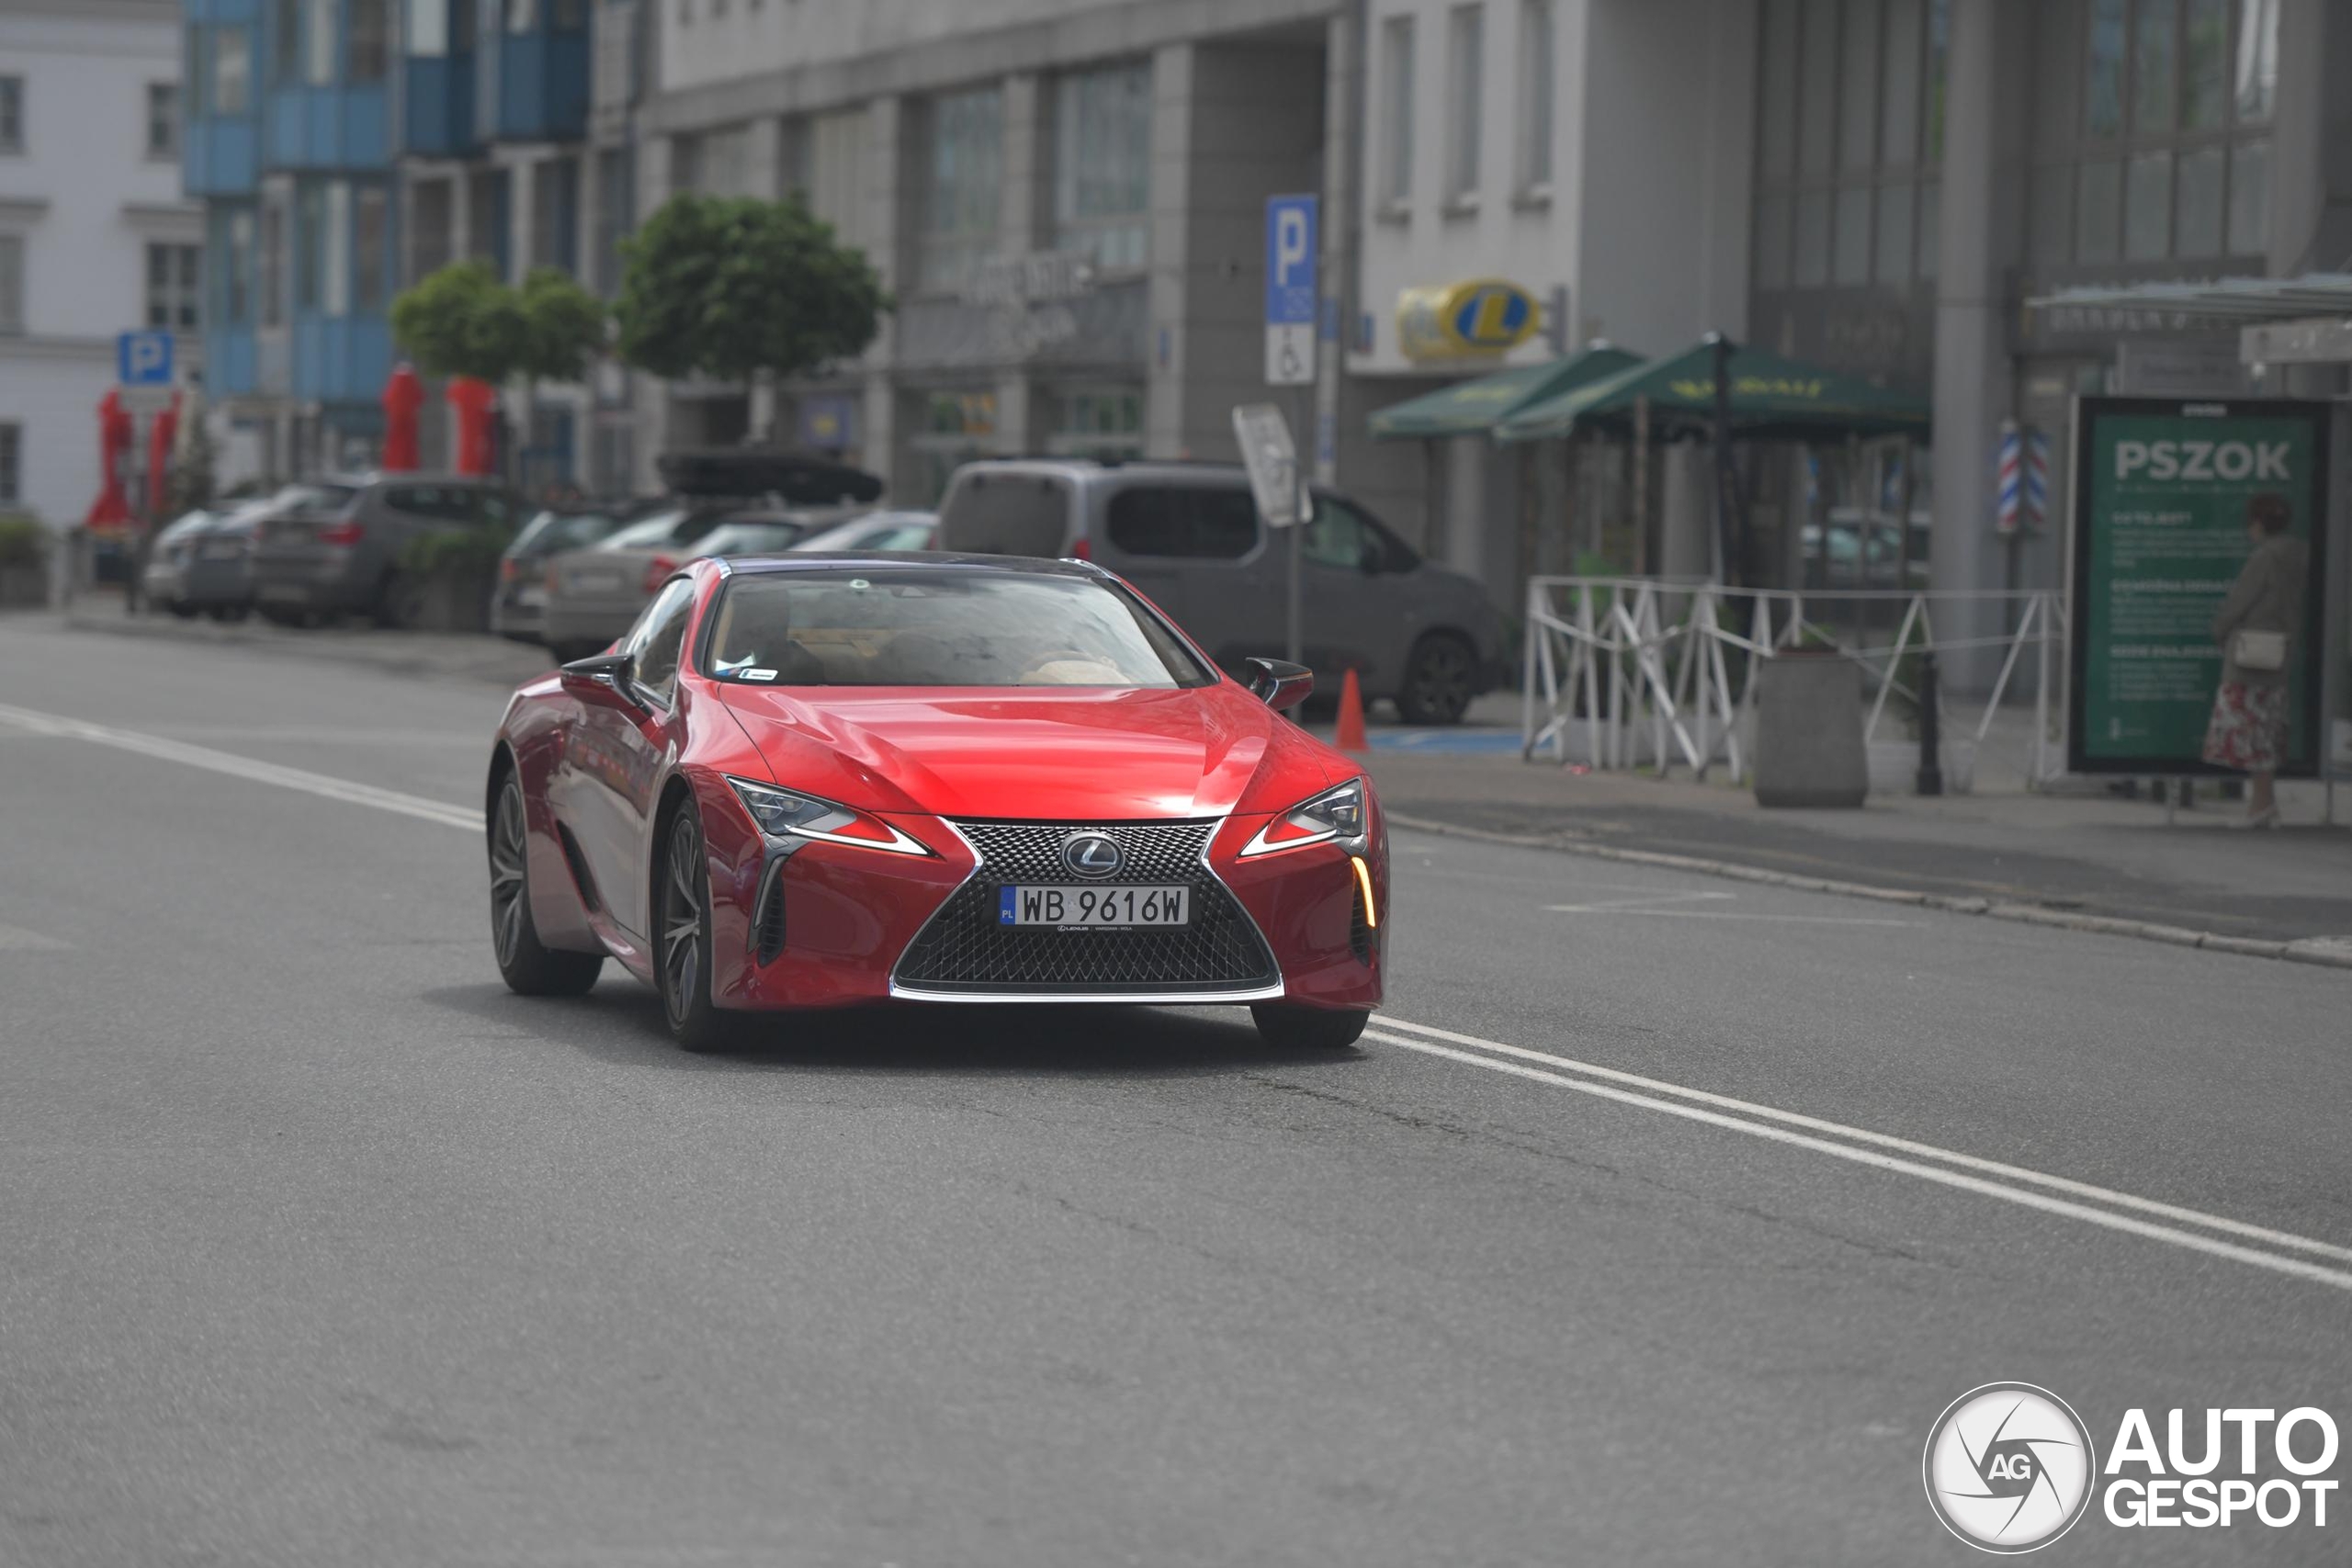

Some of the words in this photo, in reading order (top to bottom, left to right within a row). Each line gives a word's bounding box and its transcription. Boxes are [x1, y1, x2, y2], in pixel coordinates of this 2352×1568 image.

[1276, 208, 1307, 287] P
[130, 337, 163, 378] P
[2115, 440, 2291, 480] PSZOK
[1001, 909, 1013, 919] PL
[1023, 890, 1065, 921] WB
[1079, 890, 1182, 921] 9616W
